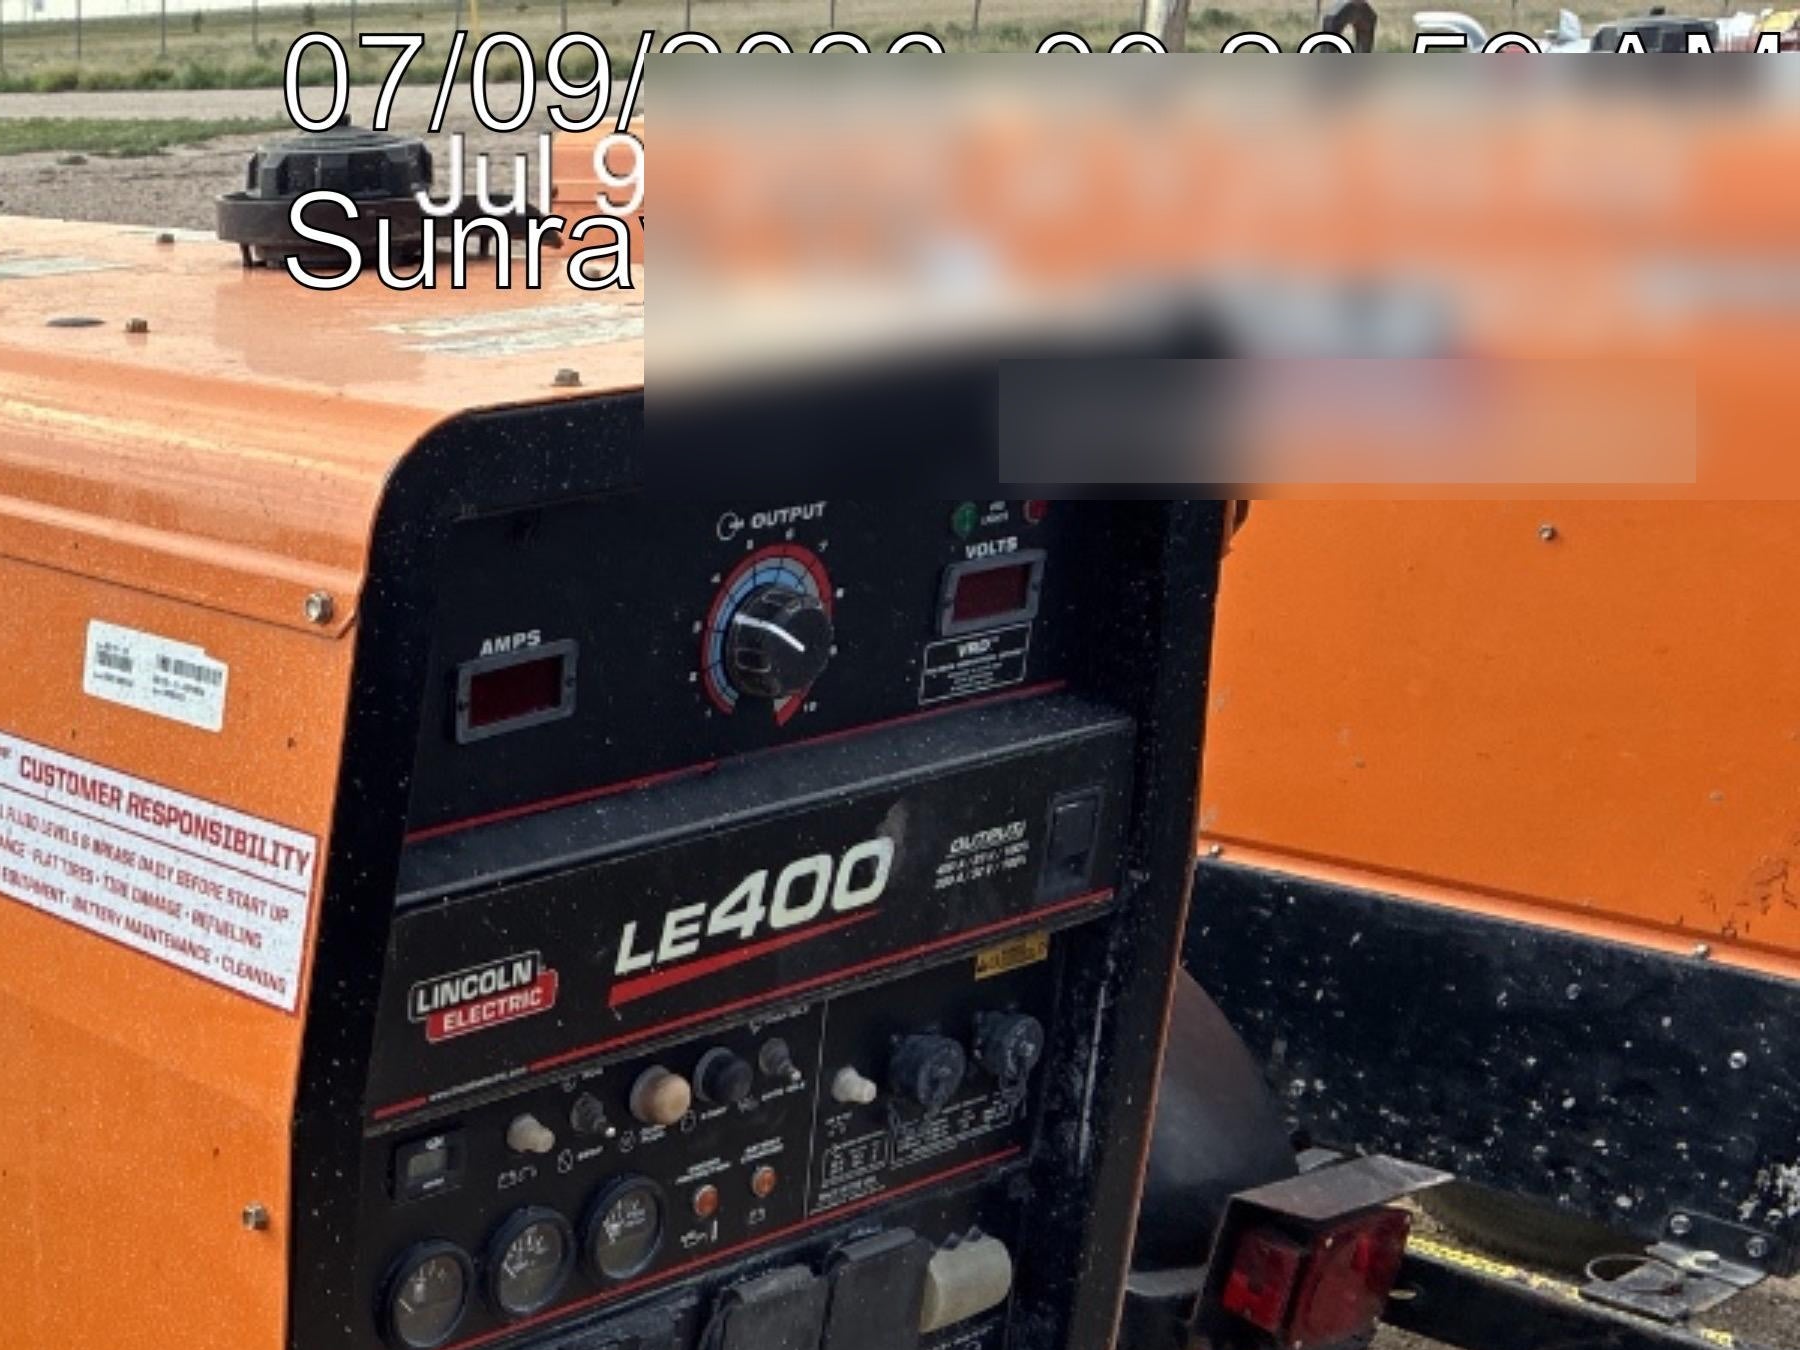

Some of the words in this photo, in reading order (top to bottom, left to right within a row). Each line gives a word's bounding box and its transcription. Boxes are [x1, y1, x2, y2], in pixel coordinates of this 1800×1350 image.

[751, 500, 827, 529] OUTPUT
[965, 536, 1019, 560] VOLTS
[480, 628, 542, 657] AMPS
[18, 755, 124, 813] CUSTOMER
[126, 792, 311, 876] RESPONSIBILITY
[32, 847, 61, 871] FLAT
[40, 815, 80, 847] LEVELS
[137, 856, 176, 882] DAILY
[176, 868, 225, 901] BEFORE
[226, 887, 268, 918] START
[269, 903, 290, 925] UP
[614, 836, 895, 976] LE400
[124, 916, 214, 965] MAINTENANCE
[220, 955, 287, 995] CLEANING
[414, 958, 534, 1015] LINCOLN
[442, 988, 544, 1034] ELECTRIC
